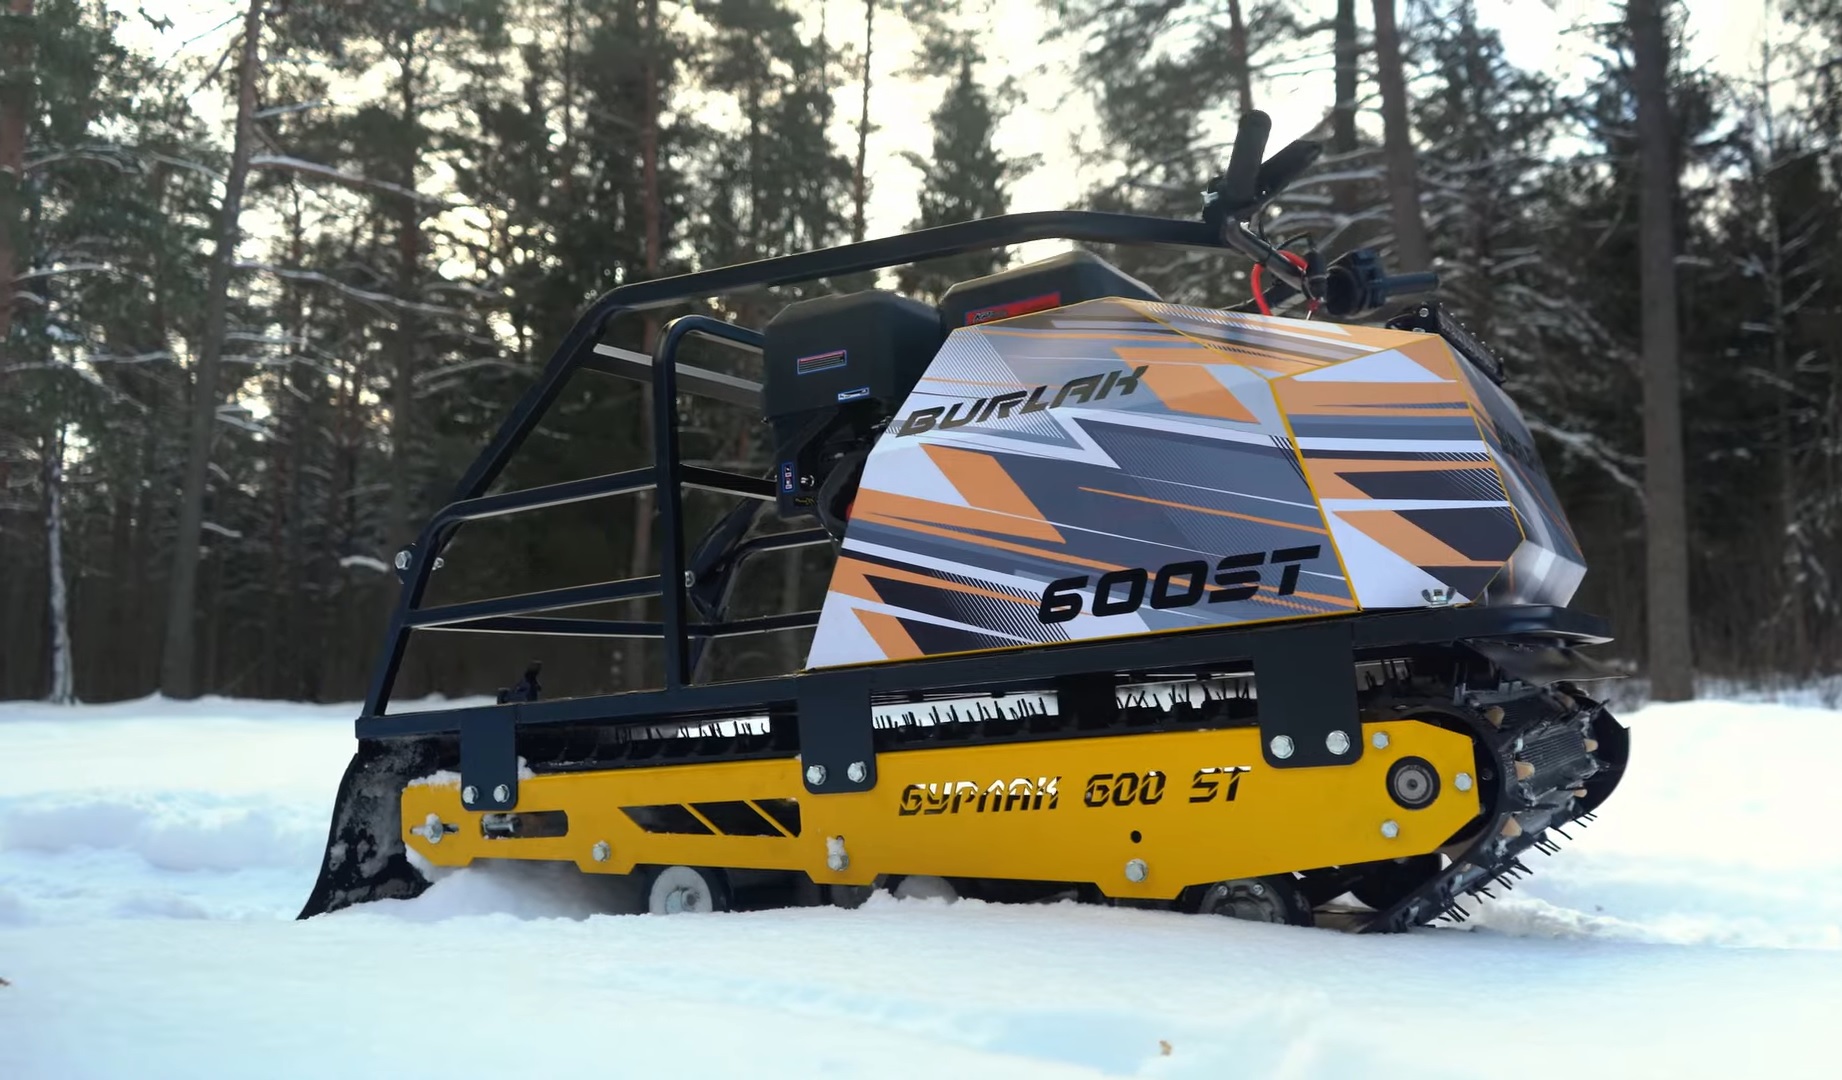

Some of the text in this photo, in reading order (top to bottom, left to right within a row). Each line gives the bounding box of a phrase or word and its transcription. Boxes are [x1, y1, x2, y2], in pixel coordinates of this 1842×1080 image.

[896, 365, 1148, 437] BURLAK
[1038, 545, 1322, 624] 600ST
[899, 765, 1251, 816] БУРЛАК 600 ST
